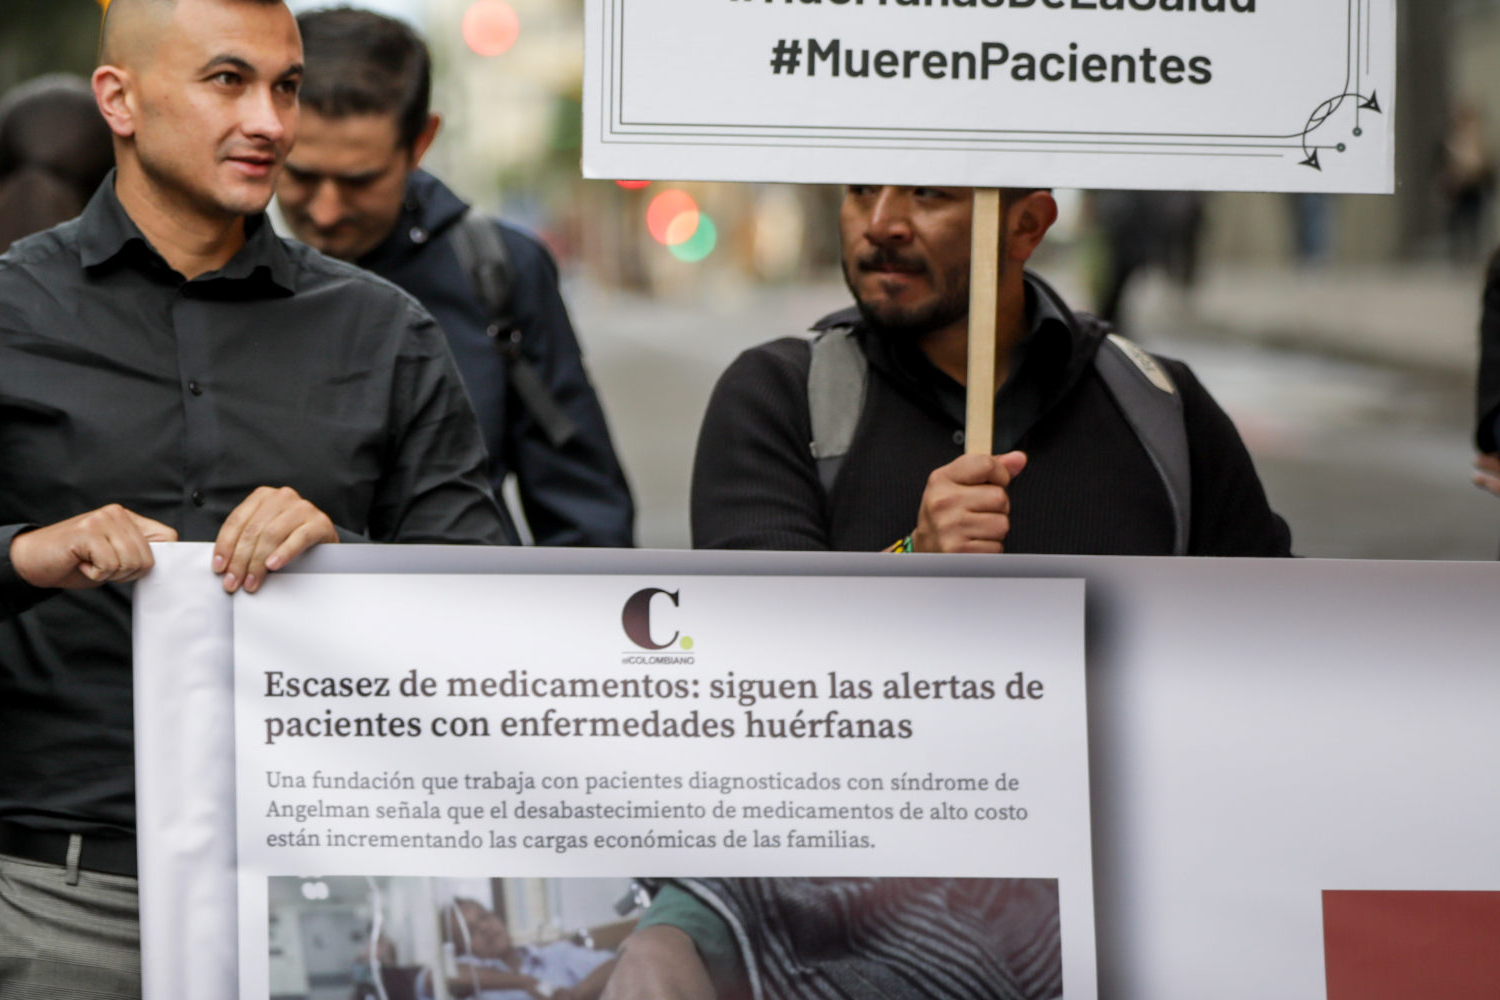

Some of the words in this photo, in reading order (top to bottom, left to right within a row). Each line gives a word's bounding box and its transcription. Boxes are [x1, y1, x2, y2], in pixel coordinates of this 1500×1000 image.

[770, 39, 1212, 85] #MuerenPacientes
[265, 672, 390, 697] Escasez
[400, 670, 436, 697] de
[447, 670, 699, 698] medicamentos:
[710, 671, 818, 706] siguen
[828, 672, 873, 699] las
[884, 672, 995, 699] alertas
[1006, 672, 1044, 700] de
[265, 709, 422, 744] pacientes
[431, 717, 490, 737] con
[501, 709, 735, 738] enfermedades
[745, 710, 913, 739] huérfanas
[266, 771, 306, 788] Una
[313, 771, 415, 789] fundación
[422, 777, 458, 795] que
[464, 771, 535, 795] trabaja
[542, 777, 579, 789] con
[585, 771, 683, 795] pacientes
[689, 771, 841, 794] diagnosticados
[847, 778, 884, 790] con
[891, 772, 989, 791] síndrome
[995, 773, 1019, 791] de
[265, 800, 370, 822] Angelman
[376, 801, 441, 819] señala
[448, 806, 484, 824] que
[490, 800, 508, 819] el
[514, 800, 706, 819] desabastecimiento
[712, 800, 736, 818] de
[742, 801, 894, 819] medicamentos
[899, 802, 923, 819] de
[930, 802, 968, 820] alto
[975, 805, 1028, 820] costo
[266, 828, 320, 847] están
[327, 829, 483, 848] incrementando
[489, 830, 517, 848] las
[523, 835, 588, 853] cargas
[594, 829, 716, 848] económicas
[723, 829, 747, 848] de
[753, 830, 781, 848] las
[787, 829, 875, 848] familias.
